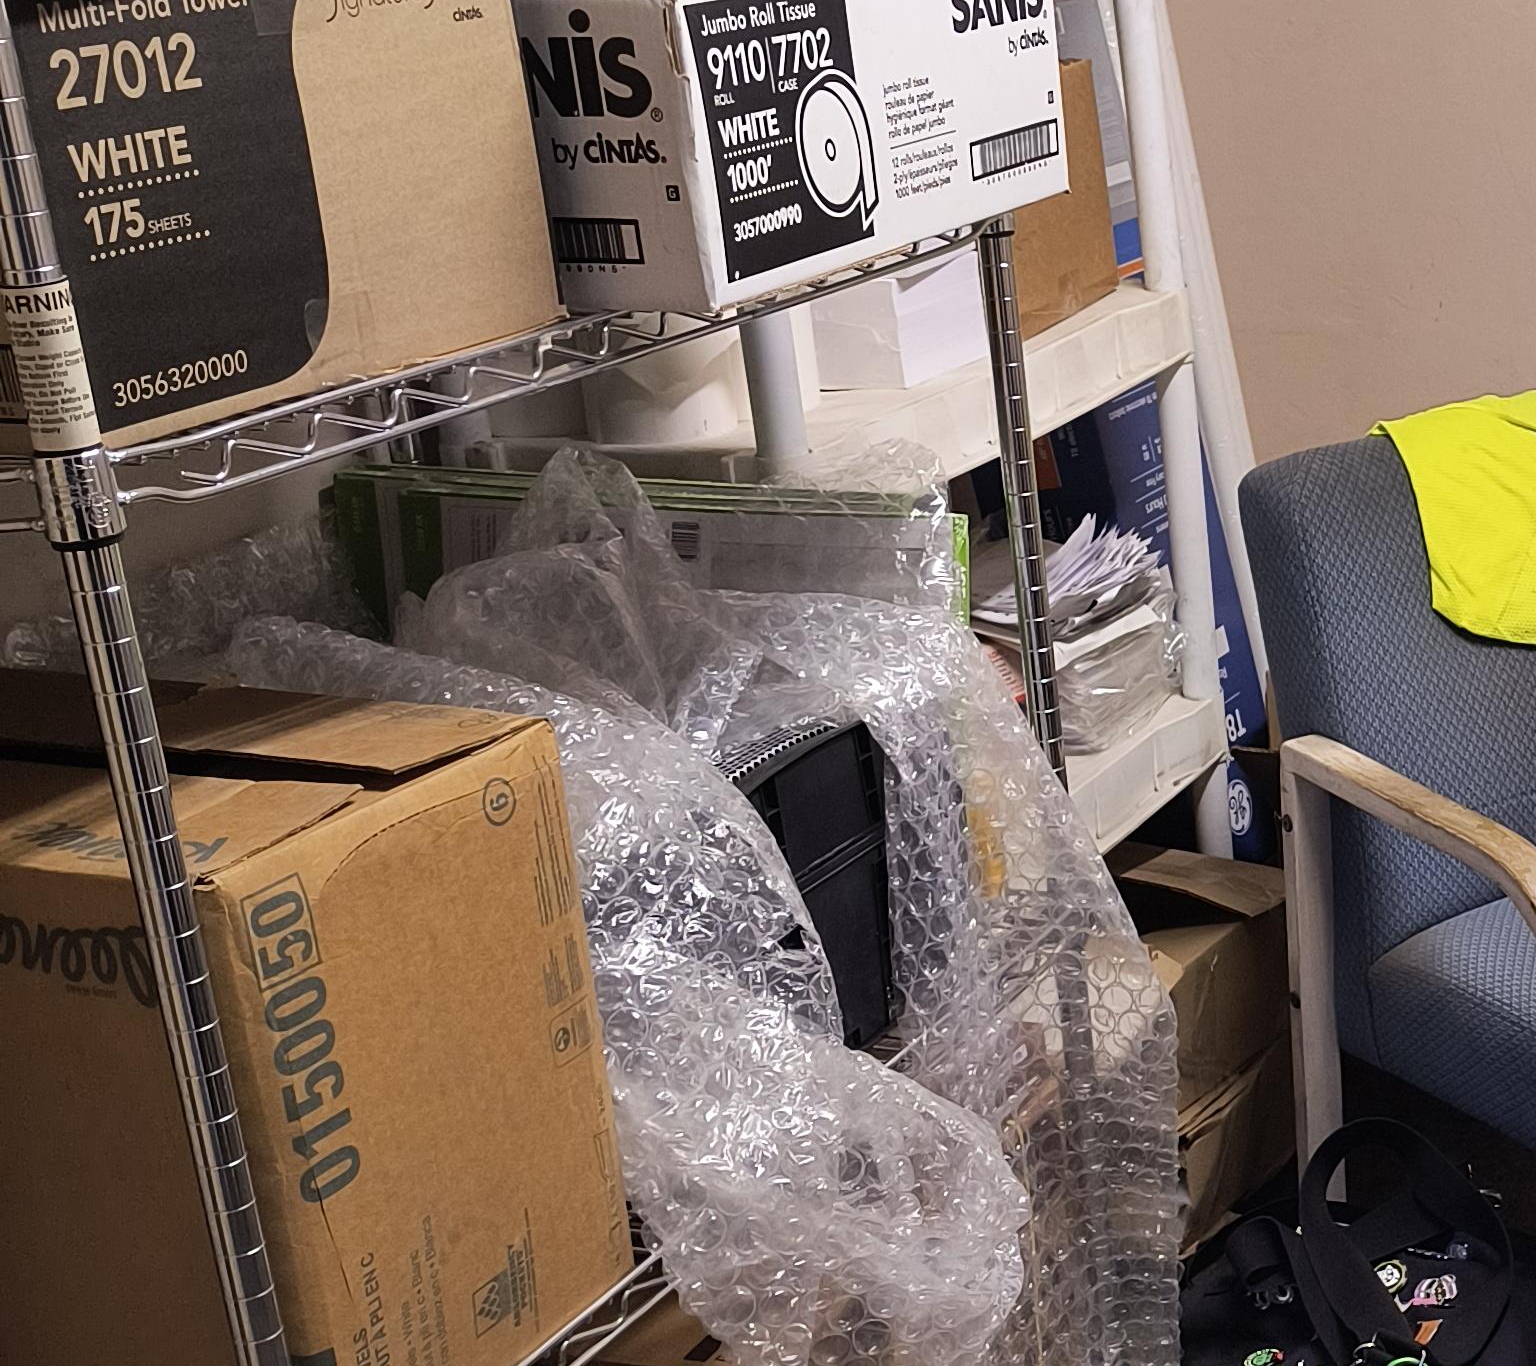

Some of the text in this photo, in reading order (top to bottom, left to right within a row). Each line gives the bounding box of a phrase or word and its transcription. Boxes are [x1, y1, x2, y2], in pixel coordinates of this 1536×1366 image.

[700, 0, 817, 37] Jumbo Roll Tissue
[706, 26, 834, 90] 9110 7702
[1008, 37, 1020, 56] by
[48, 31, 204, 112] 27012
[778, 76, 799, 94] CASE
[713, 93, 735, 107] ROLL
[717, 107, 781, 149] WHITE
[66, 124, 193, 184] WHITE
[552, 138, 579, 170] by
[83, 197, 193, 248] 175 SHEETS
[4, 289, 71, 314] ARNIN
[112, 348, 249, 409] 3056320000
[250, 890, 314, 980] 50
[263, 976, 362, 1205] 01500
[360, 1252, 375, 1268] C
[408, 1249, 424, 1288] Blanc
[364, 1269, 381, 1295] EN
[366, 1295, 384, 1324] PLI
[399, 1300, 414, 1340] White
